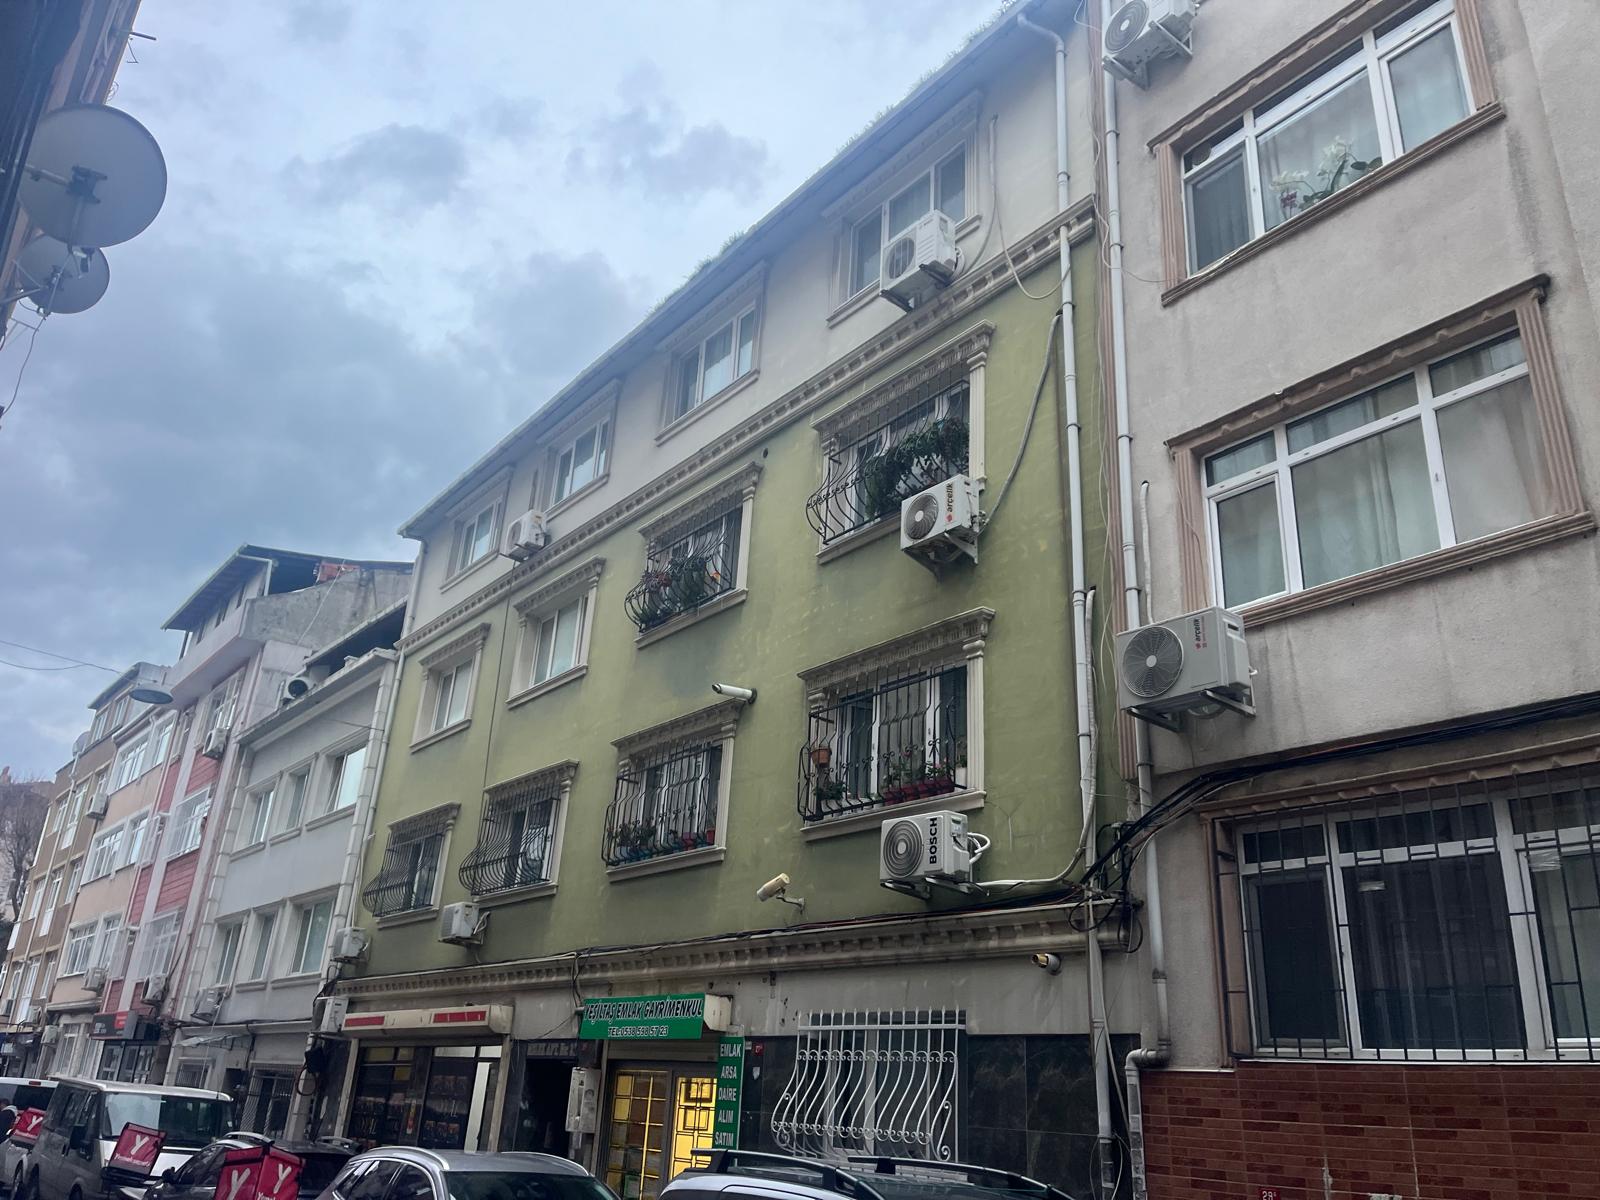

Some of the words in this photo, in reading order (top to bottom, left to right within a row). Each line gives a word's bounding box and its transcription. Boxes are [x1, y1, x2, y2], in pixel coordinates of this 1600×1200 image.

[929, 817, 938, 864] BOSCH
[616, 1002, 643, 1020] EMLAK
[644, 996, 703, 1019] GAYRİMENKUL
[720, 1043, 742, 1057] EMLAK
[721, 1066, 737, 1079] ARSA
[718, 1085, 737, 1101] DAİRE
[718, 1110, 734, 1123] ALIM
[715, 1131, 734, 1147] SATIM
